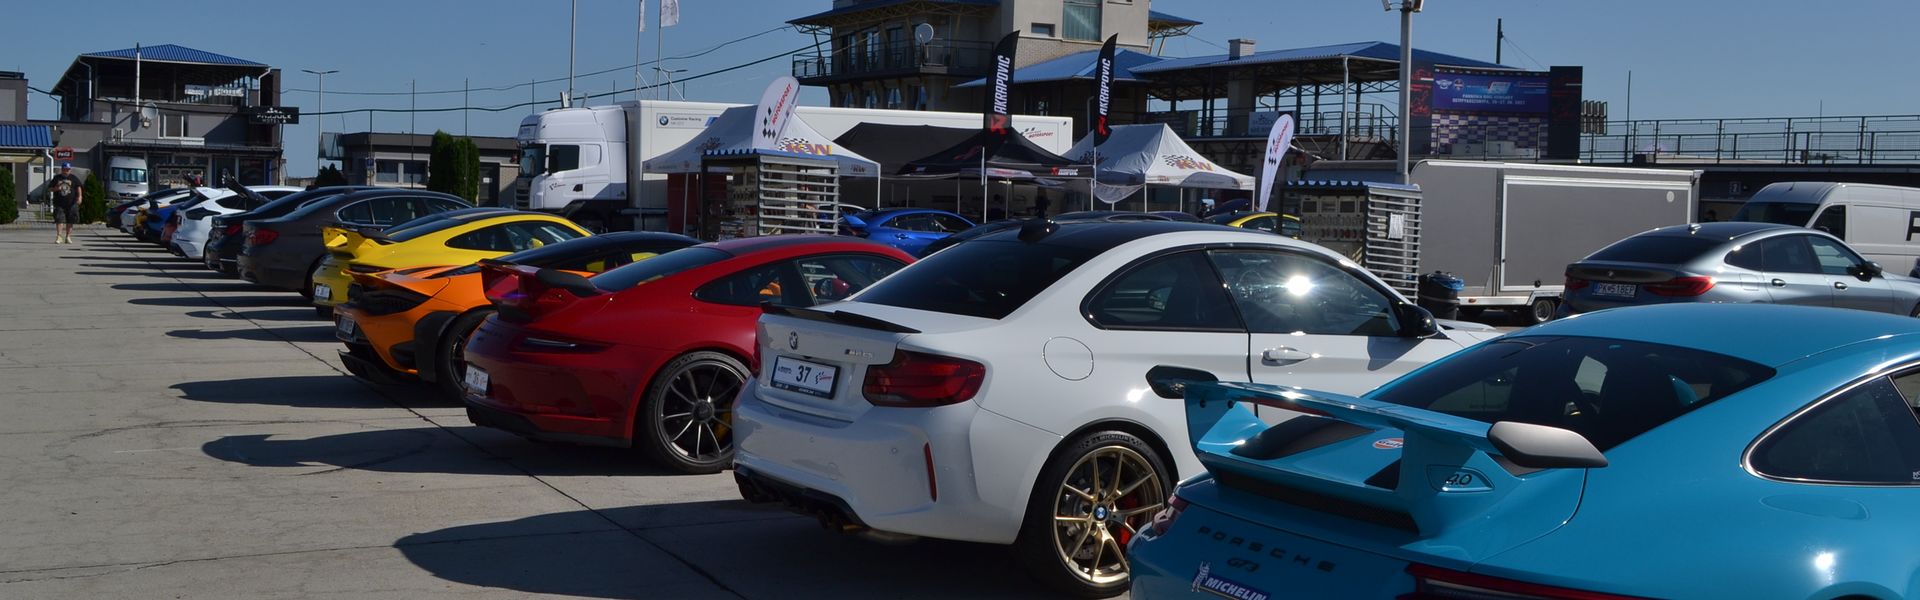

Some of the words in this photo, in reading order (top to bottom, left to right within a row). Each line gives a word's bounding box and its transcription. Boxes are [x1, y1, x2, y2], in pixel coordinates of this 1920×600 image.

[796, 365, 812, 382] 37
[1198, 526, 1336, 573] PORSCHE
[1227, 557, 1260, 573] GT3
[1205, 576, 1268, 600] MICHELIN
